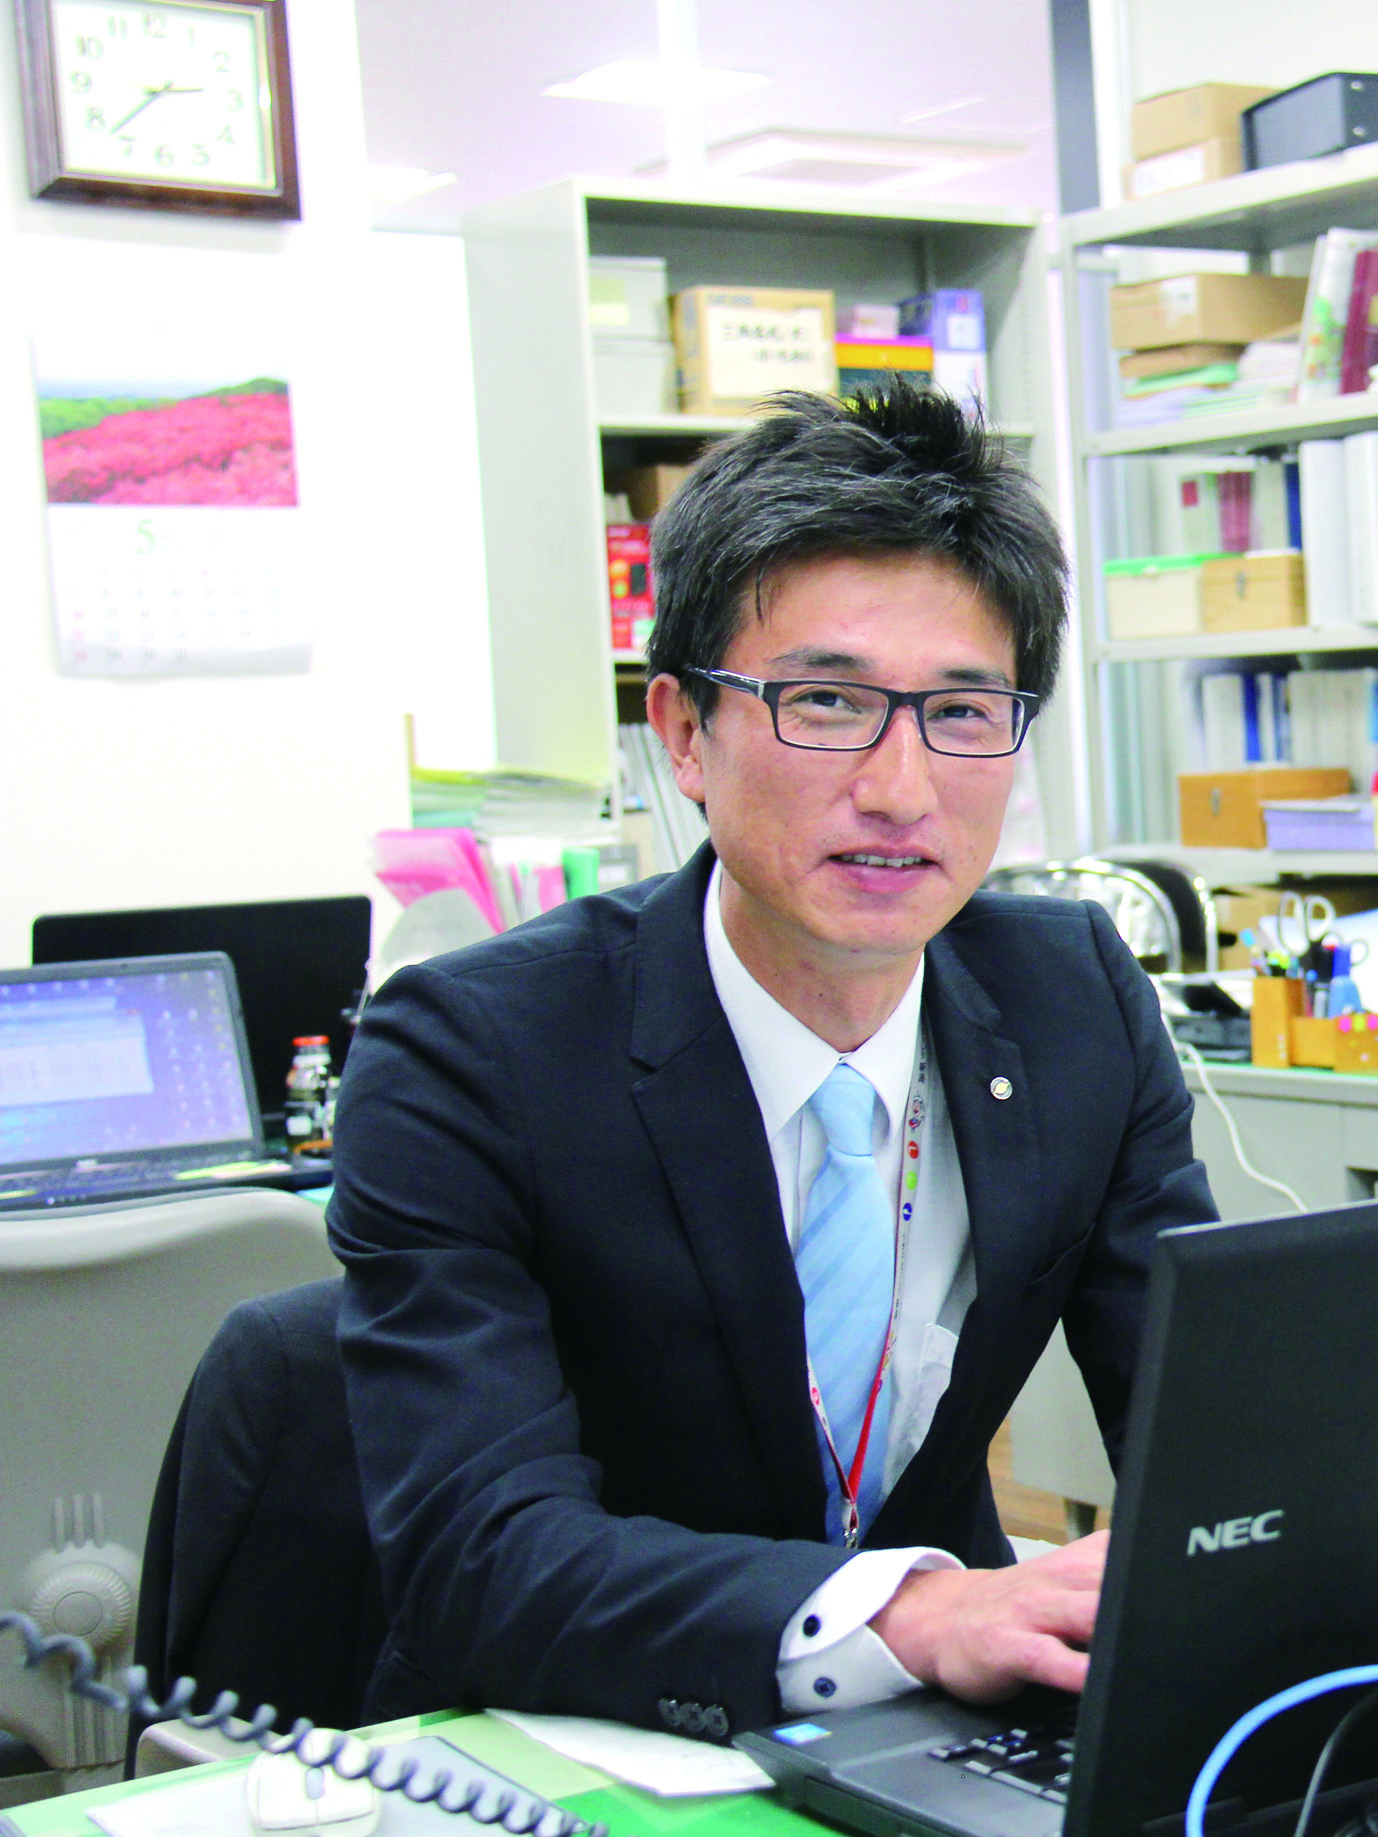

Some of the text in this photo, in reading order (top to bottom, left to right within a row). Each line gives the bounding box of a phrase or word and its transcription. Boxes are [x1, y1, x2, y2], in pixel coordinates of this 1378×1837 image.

[107, 15, 128, 39] 11
[142, 11, 168, 39] 12
[187, 26, 197, 48] 1
[75, 35, 103, 60] 10
[212, 51, 231, 73] 2
[70, 70, 93, 94] 9
[225, 89, 244, 112] 3
[85, 105, 107, 131] 8
[117, 133, 137, 159] 7
[216, 124, 236, 145] 4
[155, 145, 175, 169] 6
[191, 142, 211, 167] 5
[136, 518, 156, 556] 5
[1186, 1508, 1285, 1557] NEC
